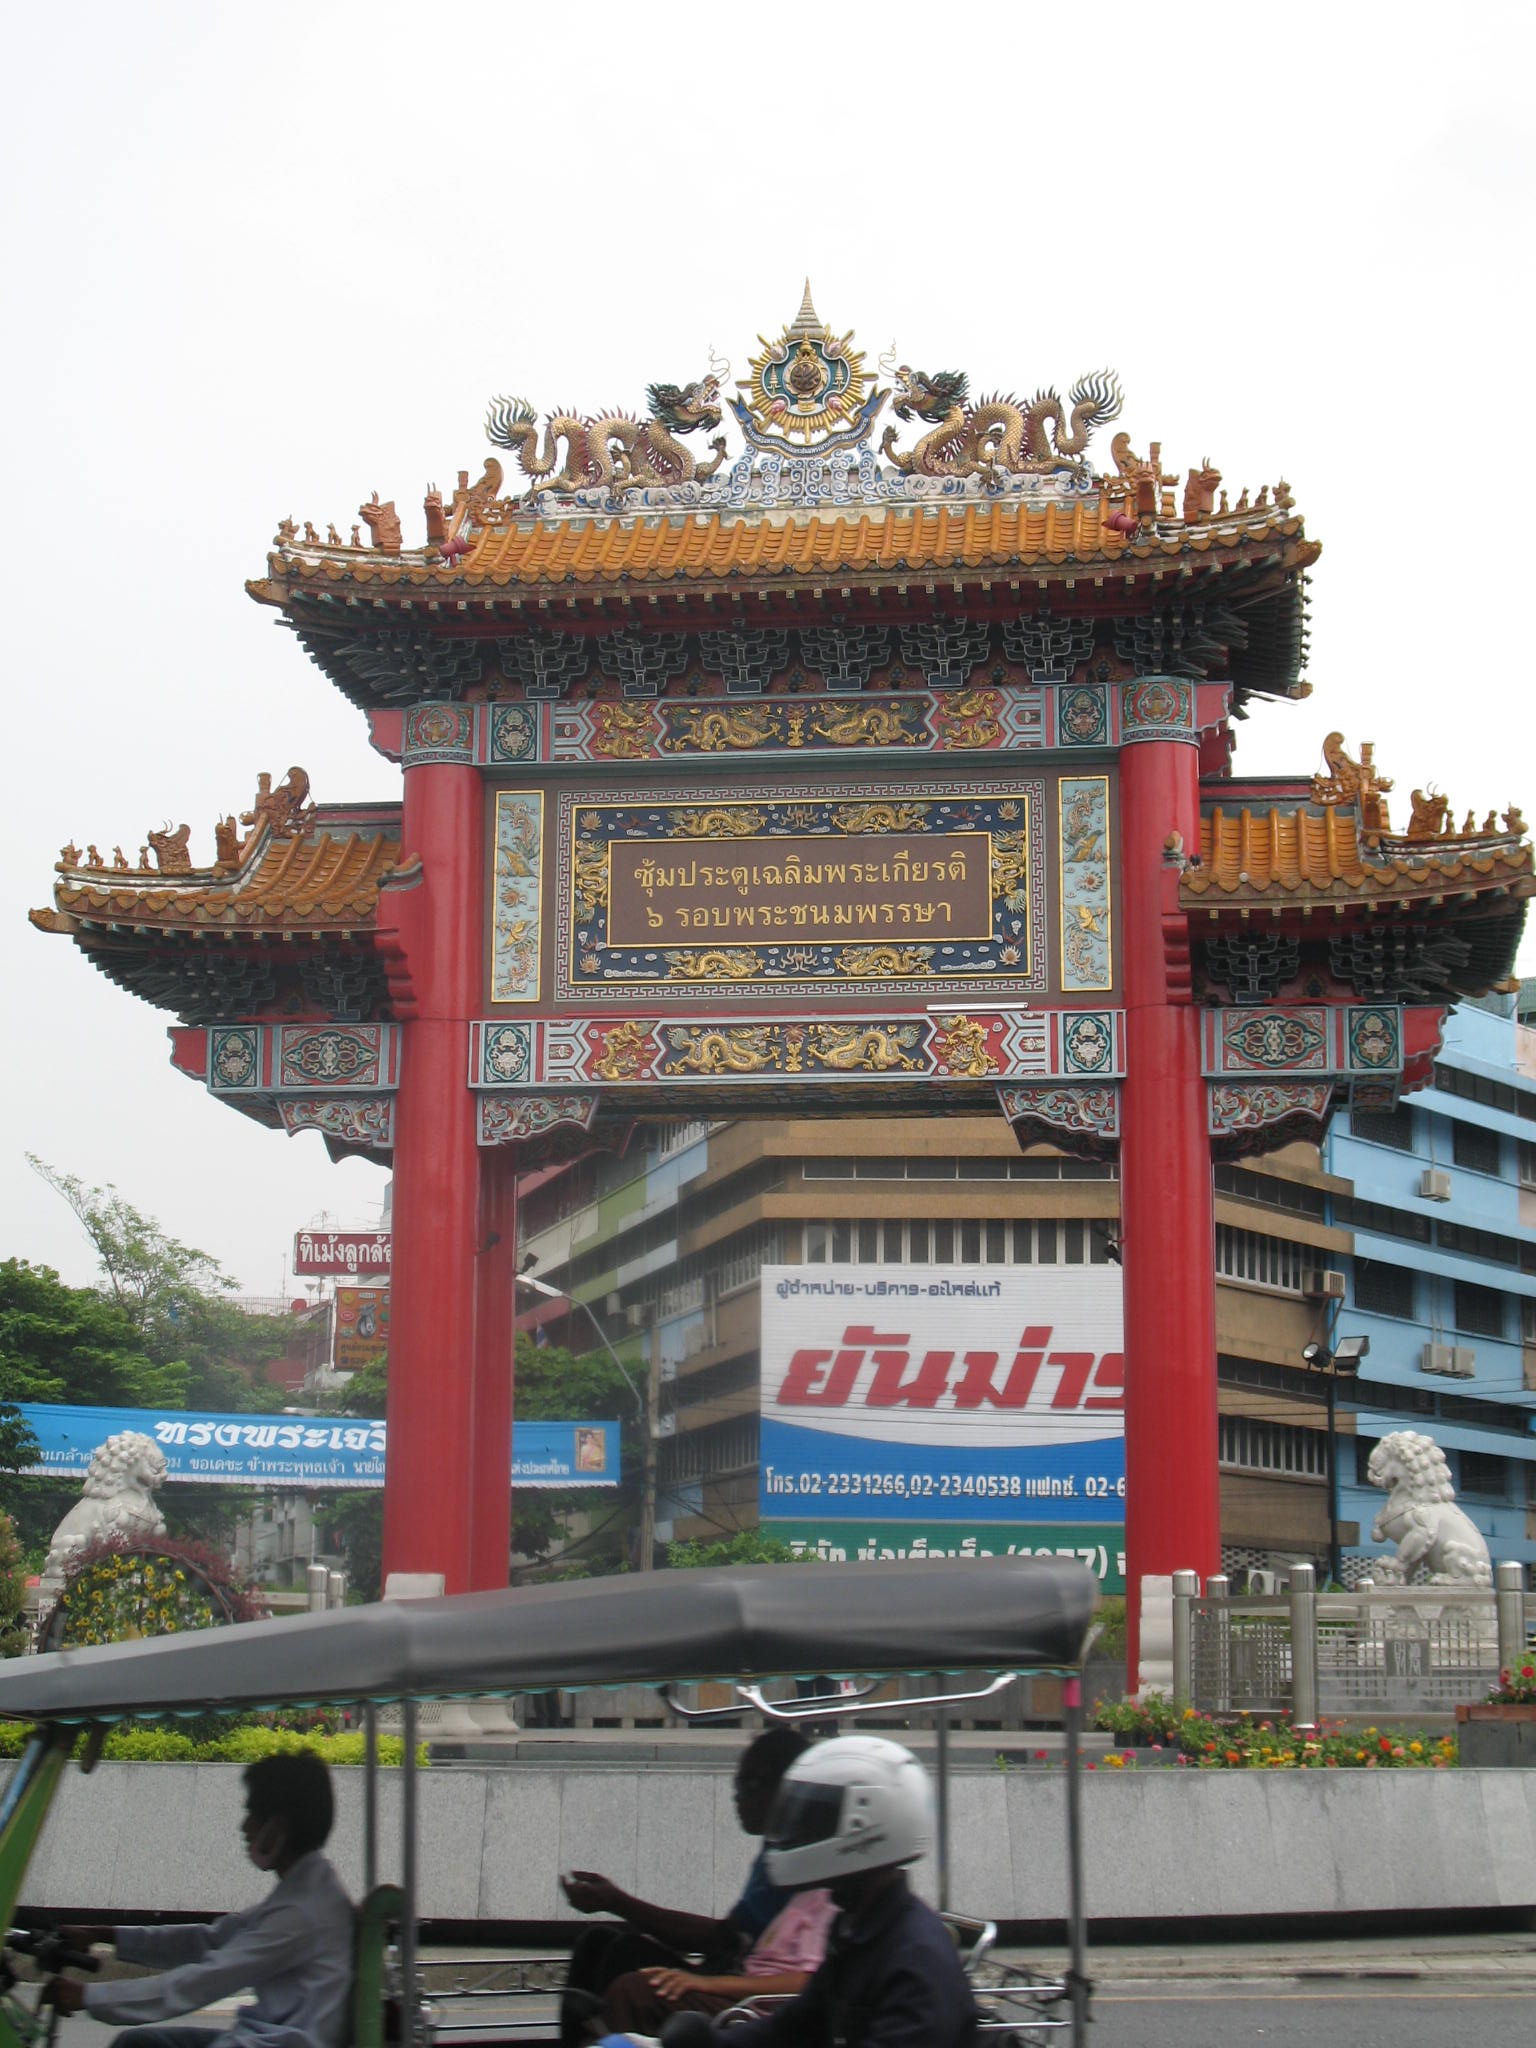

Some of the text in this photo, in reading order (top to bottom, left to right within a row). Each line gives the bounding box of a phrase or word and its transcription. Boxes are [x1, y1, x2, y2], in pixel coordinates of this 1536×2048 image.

[633, 850, 967, 897] ซุ้มประตูเฉลิมพระเกียรติ
[646, 901, 952, 928] ๖ รอบพระชนมพรรษา
